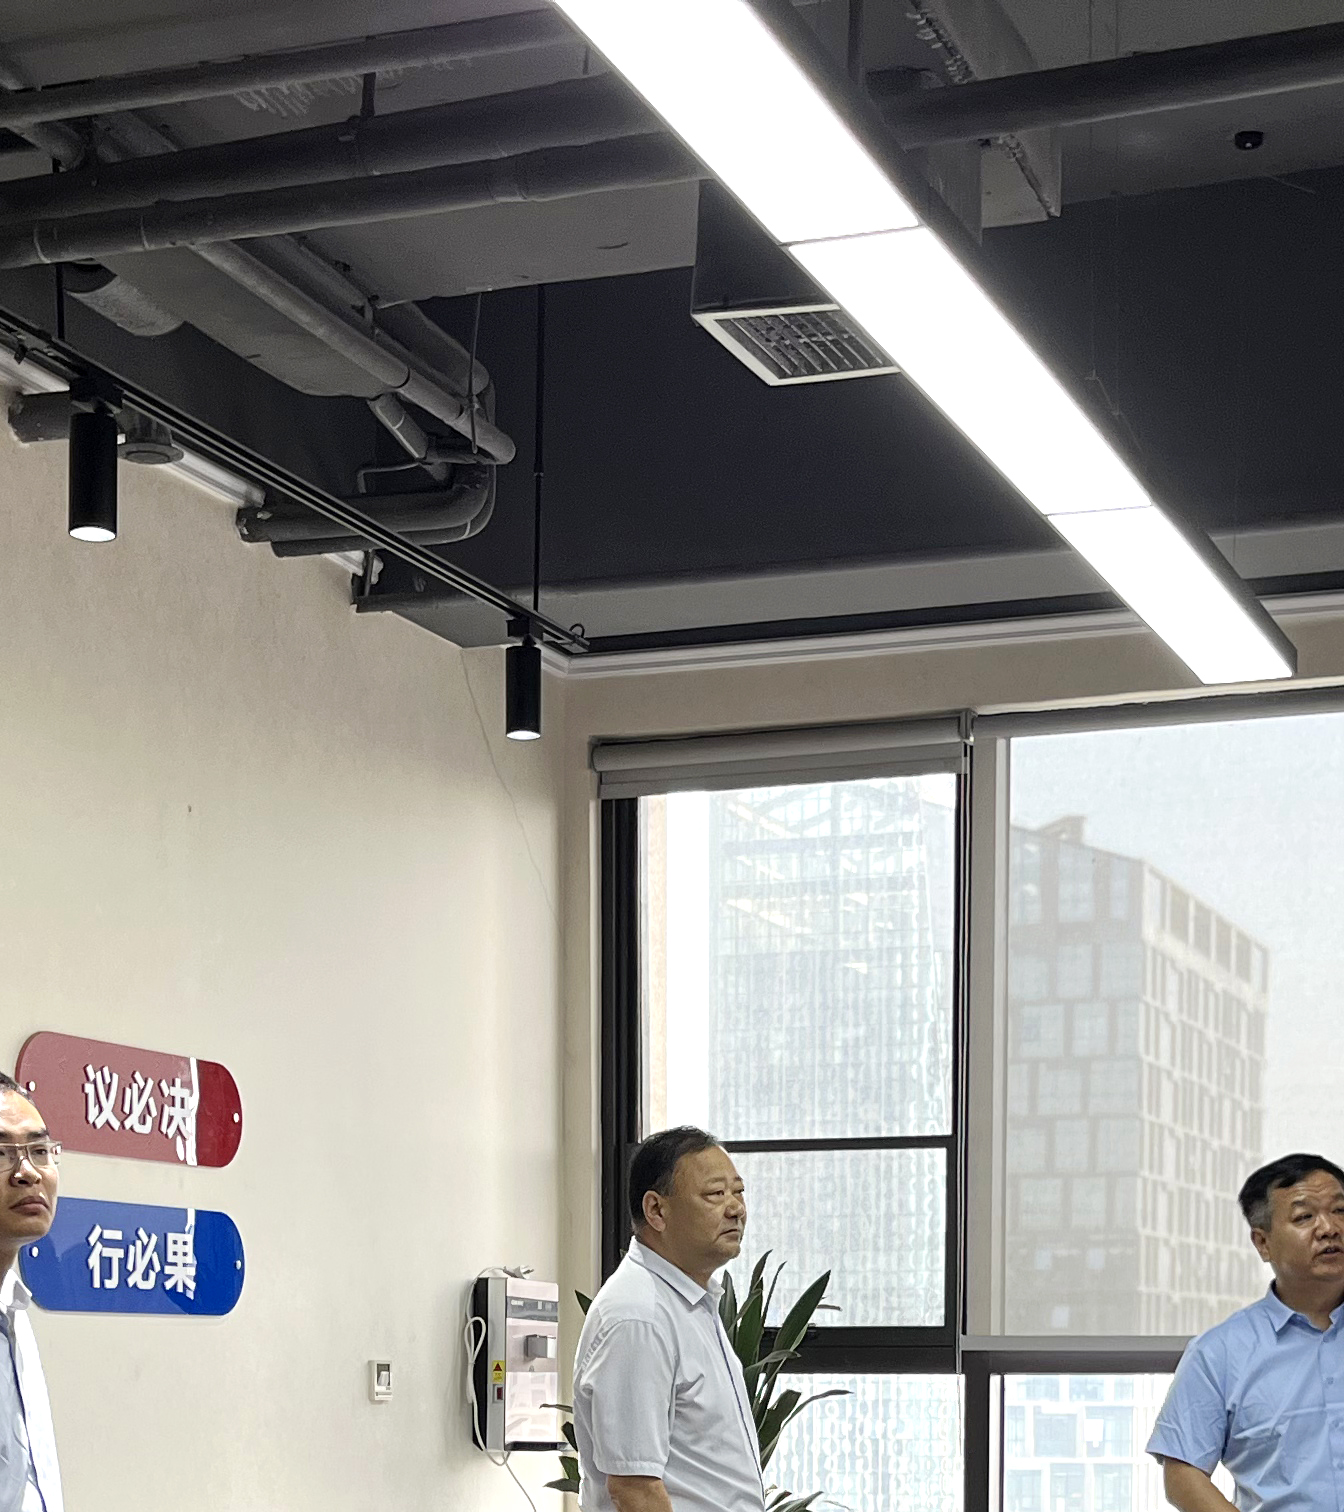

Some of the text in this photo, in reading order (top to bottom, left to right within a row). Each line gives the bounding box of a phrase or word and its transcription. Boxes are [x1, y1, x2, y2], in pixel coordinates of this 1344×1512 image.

[83, 1064, 193, 1140] 议必决
[88, 1224, 198, 1296] 行必果
